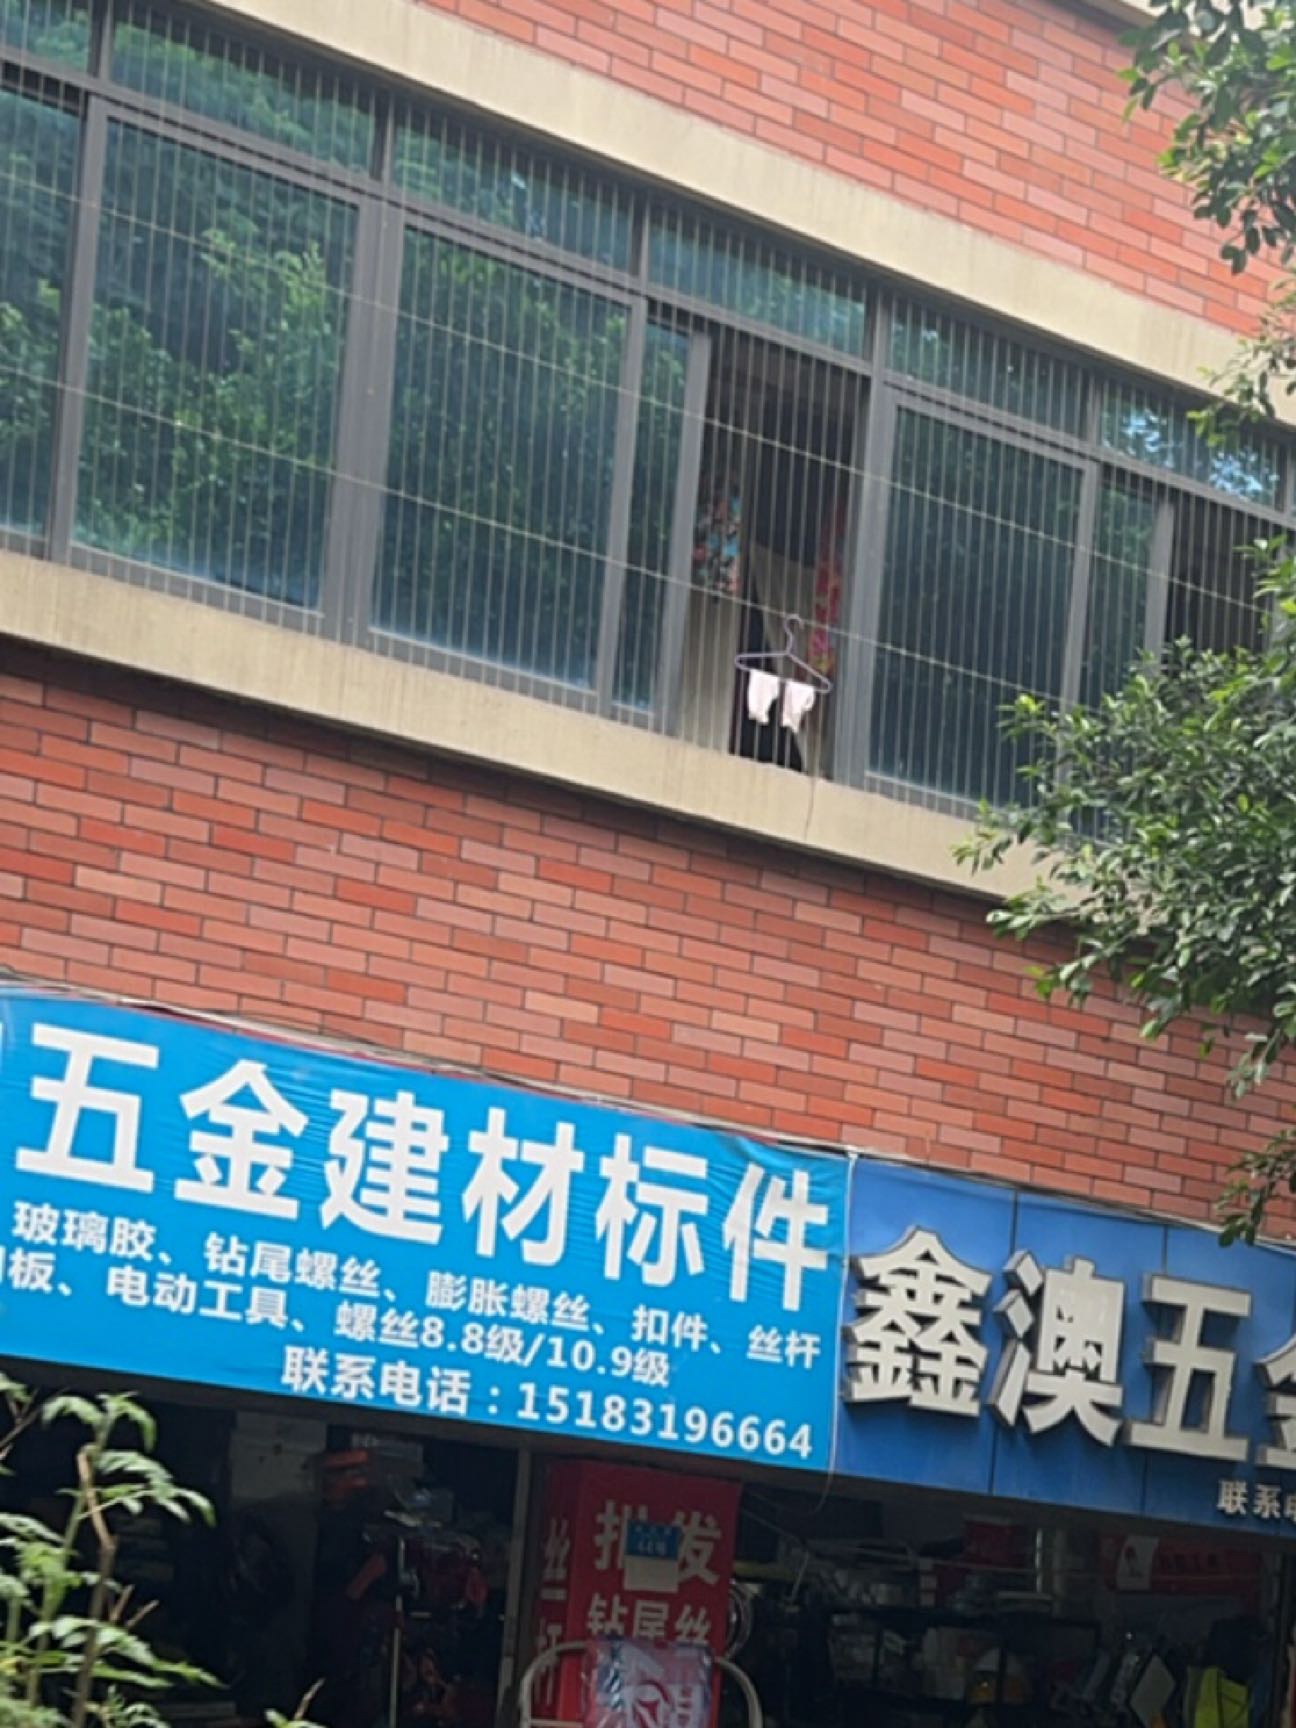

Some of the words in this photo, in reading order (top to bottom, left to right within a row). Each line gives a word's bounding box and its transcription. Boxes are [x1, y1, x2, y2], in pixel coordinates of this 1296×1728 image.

[15, 1022, 830, 1312] 五金建材标件
[0, 1245, 670, 1388] 板、电动工具、螺丝8.8级/10.9级
